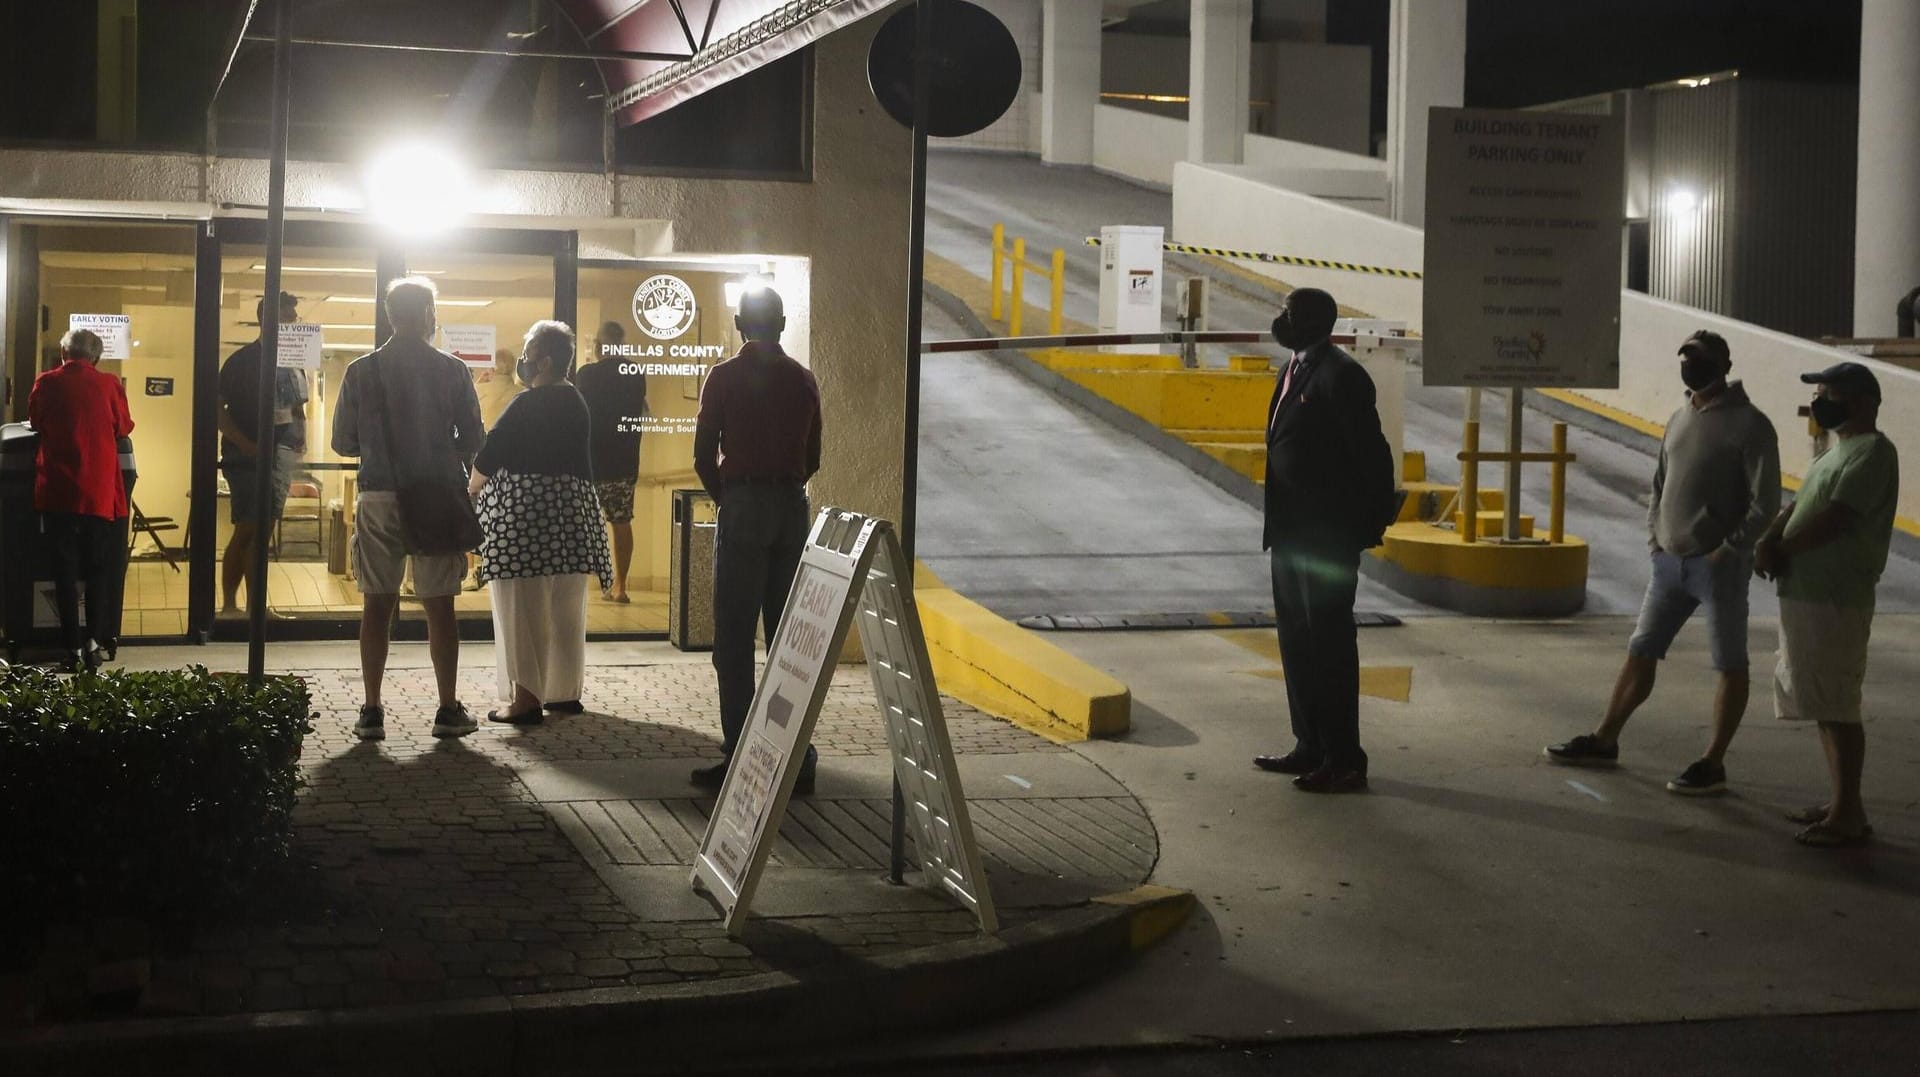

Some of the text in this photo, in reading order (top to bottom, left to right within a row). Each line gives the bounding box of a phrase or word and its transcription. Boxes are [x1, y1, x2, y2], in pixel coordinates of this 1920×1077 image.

[1454, 118, 1601, 139] BUILDING TENANT
[1468, 145, 1586, 165] PARKING ONLY
[1482, 305, 1505, 316] TOW
[601, 344, 725, 358] PINELLAS COUNTY
[618, 363, 708, 376] GOVERNMENT
[621, 416, 658, 424] Facility
[617, 424, 629, 432] St.
[631, 424, 674, 434] Petersburg
[800, 579, 838, 618] EARLY
[785, 616, 827, 661] VOTING
